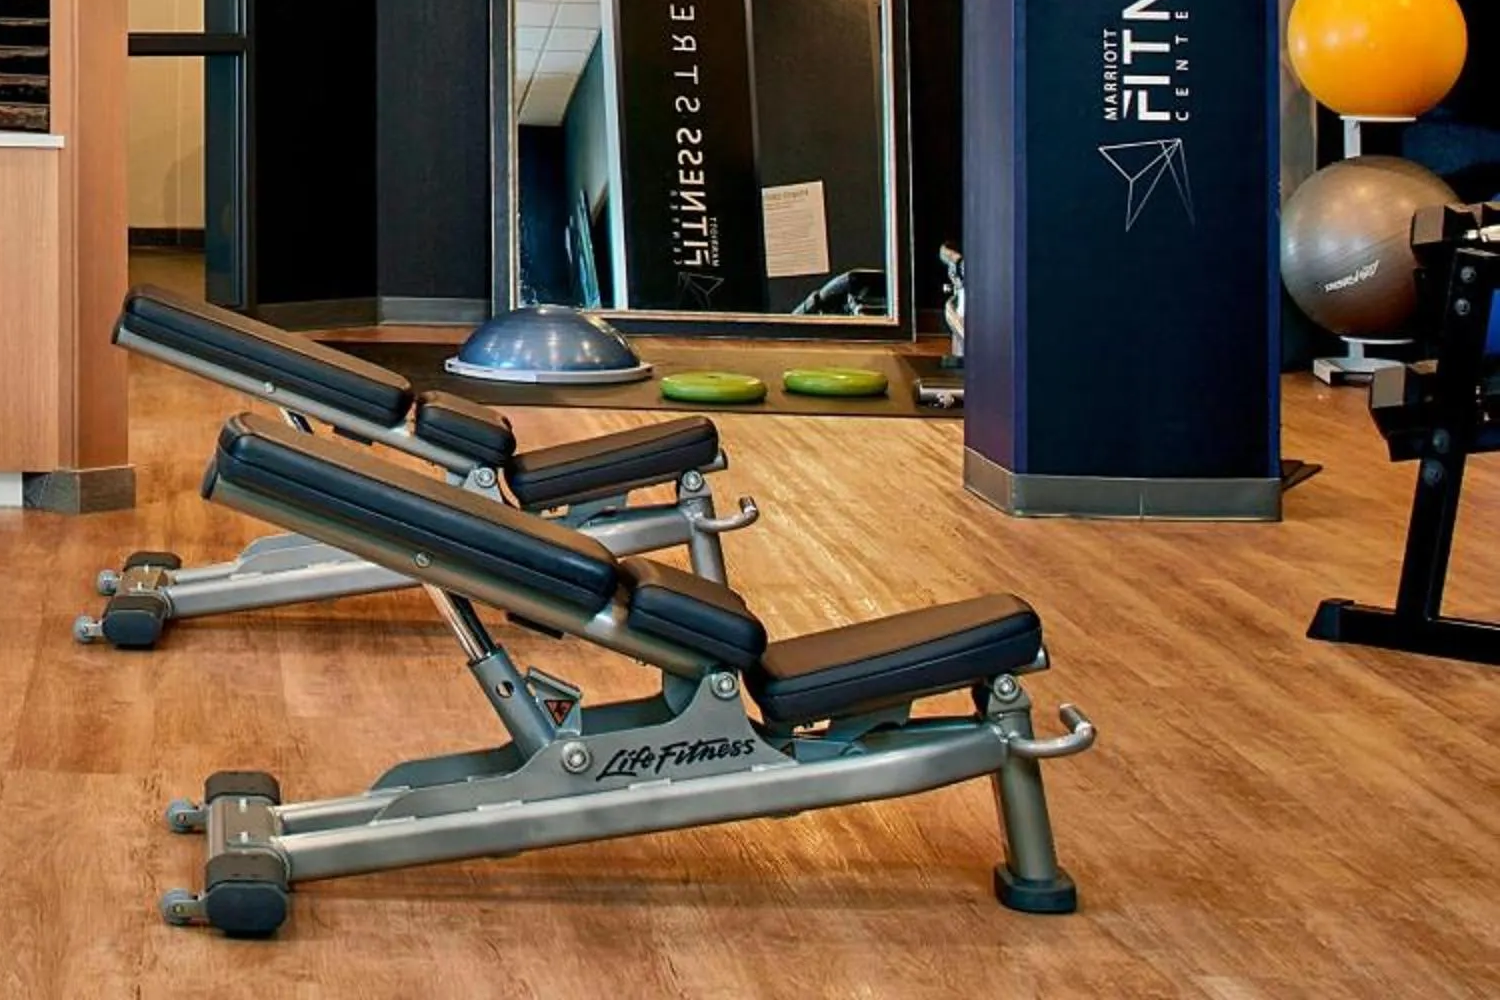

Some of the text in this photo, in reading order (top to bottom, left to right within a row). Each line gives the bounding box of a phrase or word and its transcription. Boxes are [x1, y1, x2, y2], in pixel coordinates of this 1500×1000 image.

[1103, 28, 1118, 121] MARRIOTT
[595, 737, 756, 782] Life Fitness
